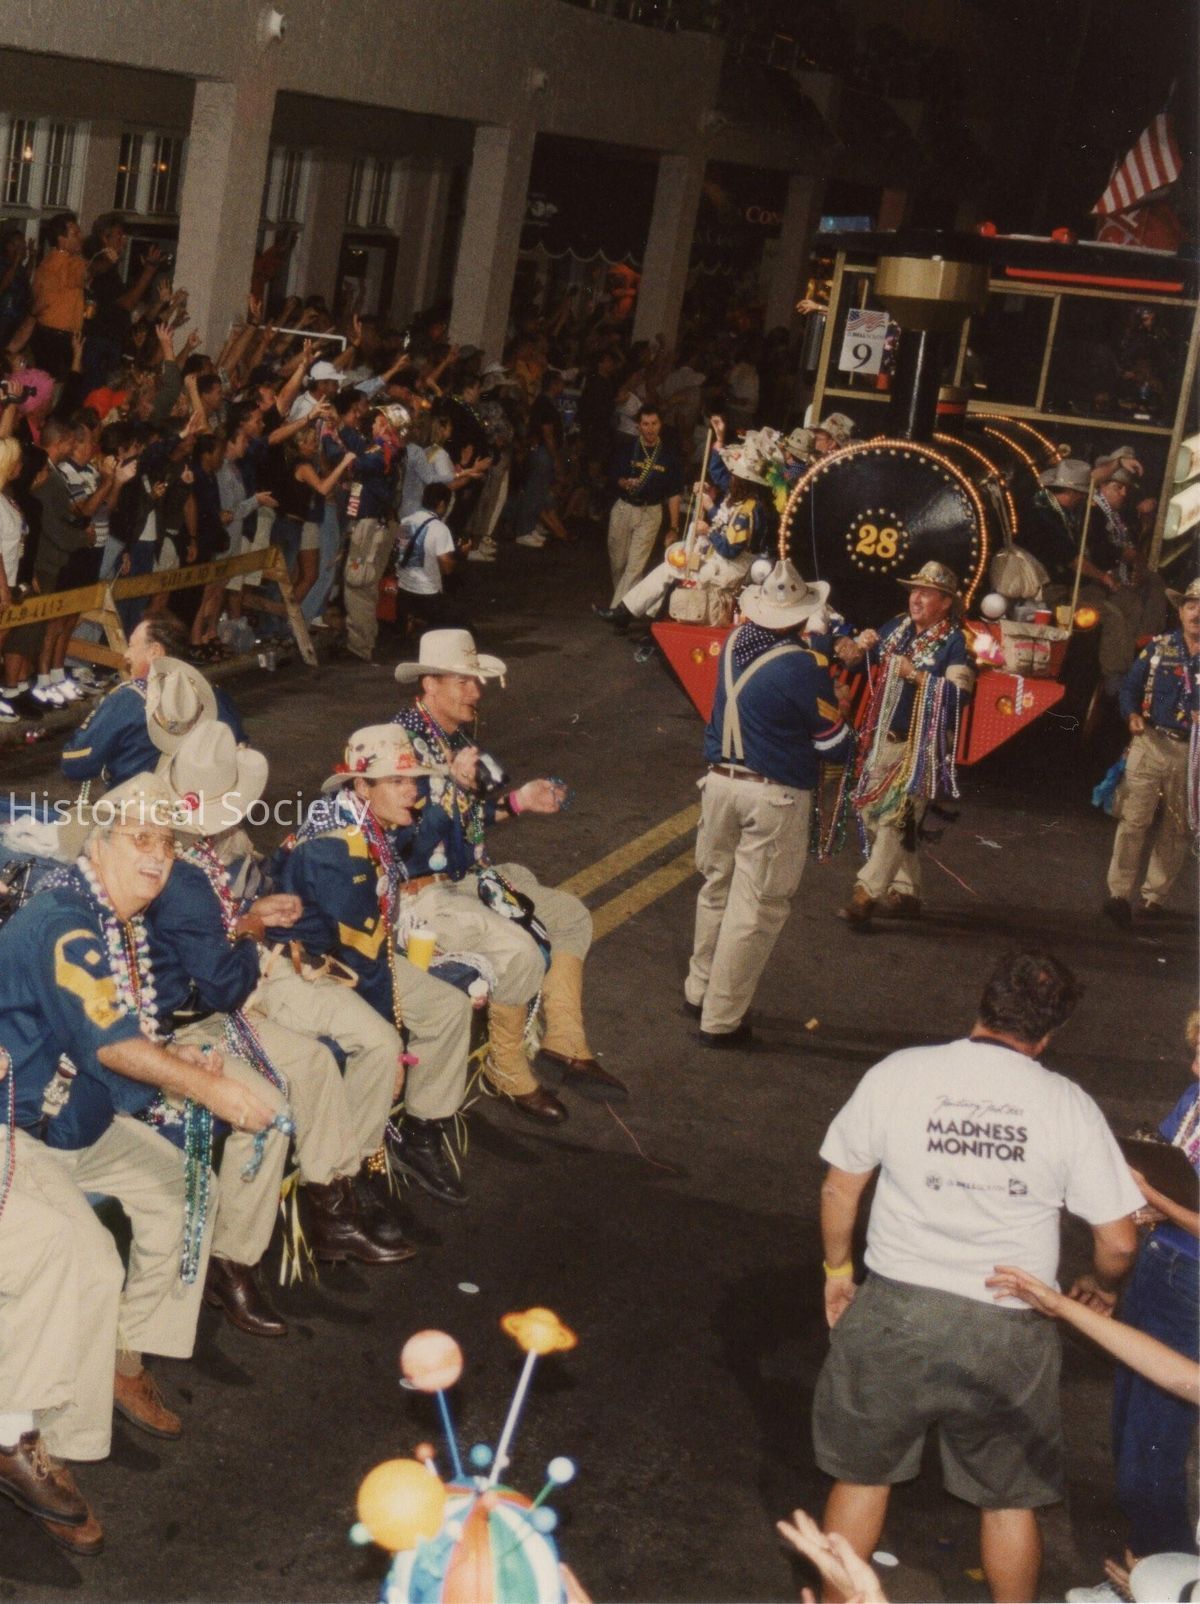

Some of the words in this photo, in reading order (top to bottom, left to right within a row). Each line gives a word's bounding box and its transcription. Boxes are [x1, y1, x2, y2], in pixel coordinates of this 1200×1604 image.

[852, 343, 872, 369] 9
[856, 524, 898, 558] 28
[926, 1118, 1028, 1144] MADNESS
[927, 1137, 1026, 1162] MONITOR
